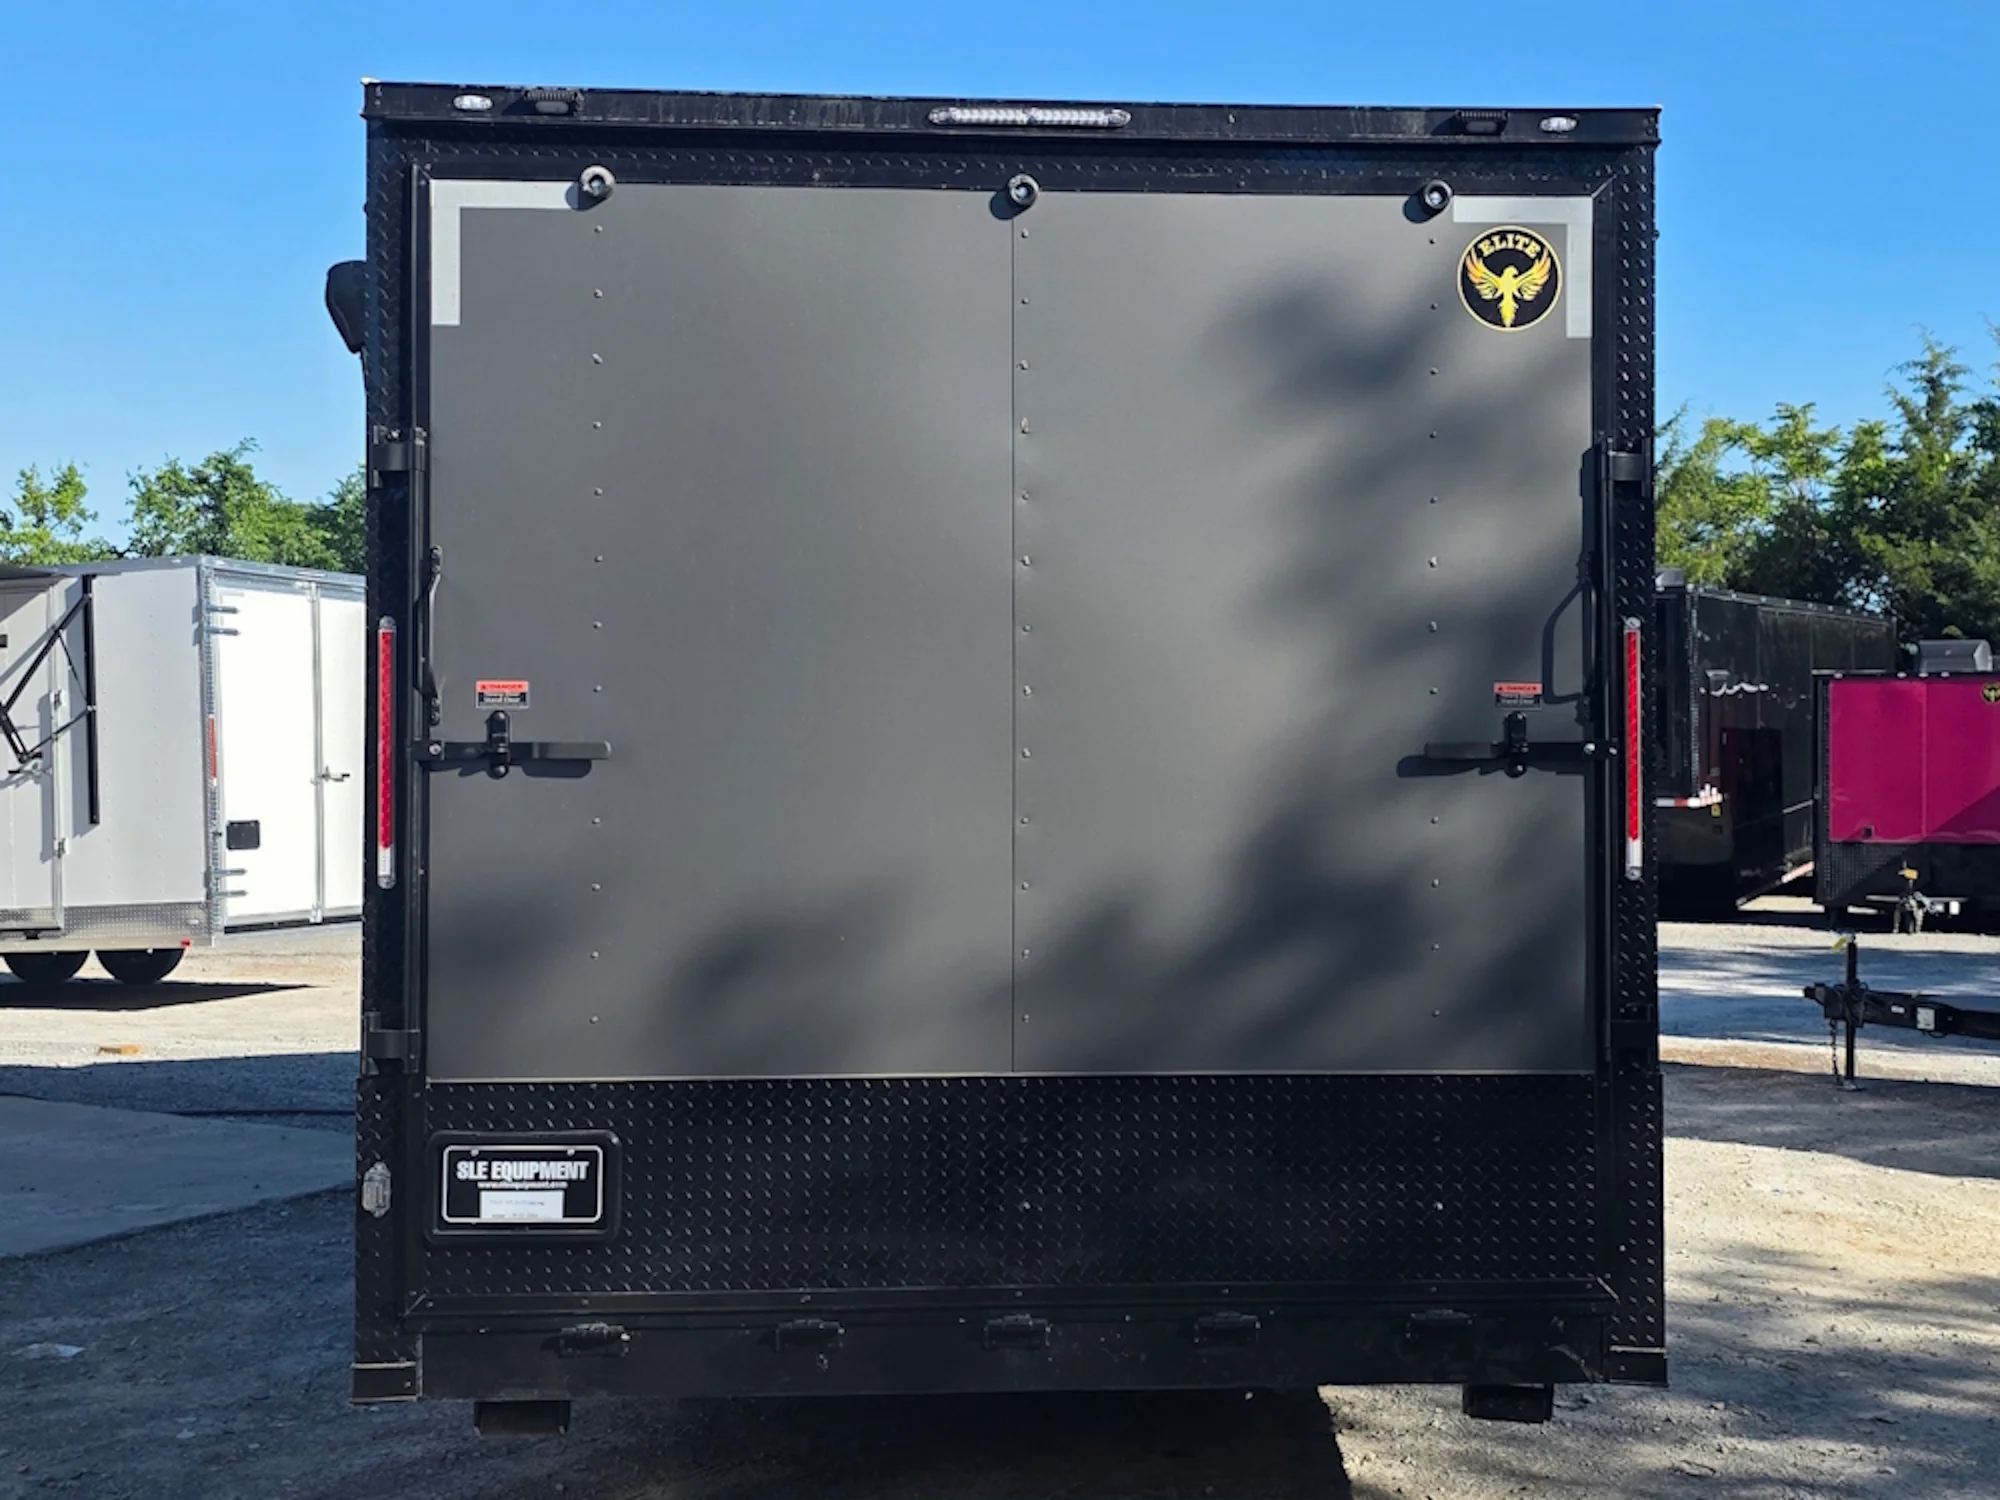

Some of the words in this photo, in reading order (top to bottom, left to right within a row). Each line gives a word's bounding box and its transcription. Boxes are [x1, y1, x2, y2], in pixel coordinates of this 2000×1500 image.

[1478, 233, 1541, 258] ELITE
[456, 1161, 488, 1179] SLE
[491, 1161, 589, 1181] EQUIPMENT
